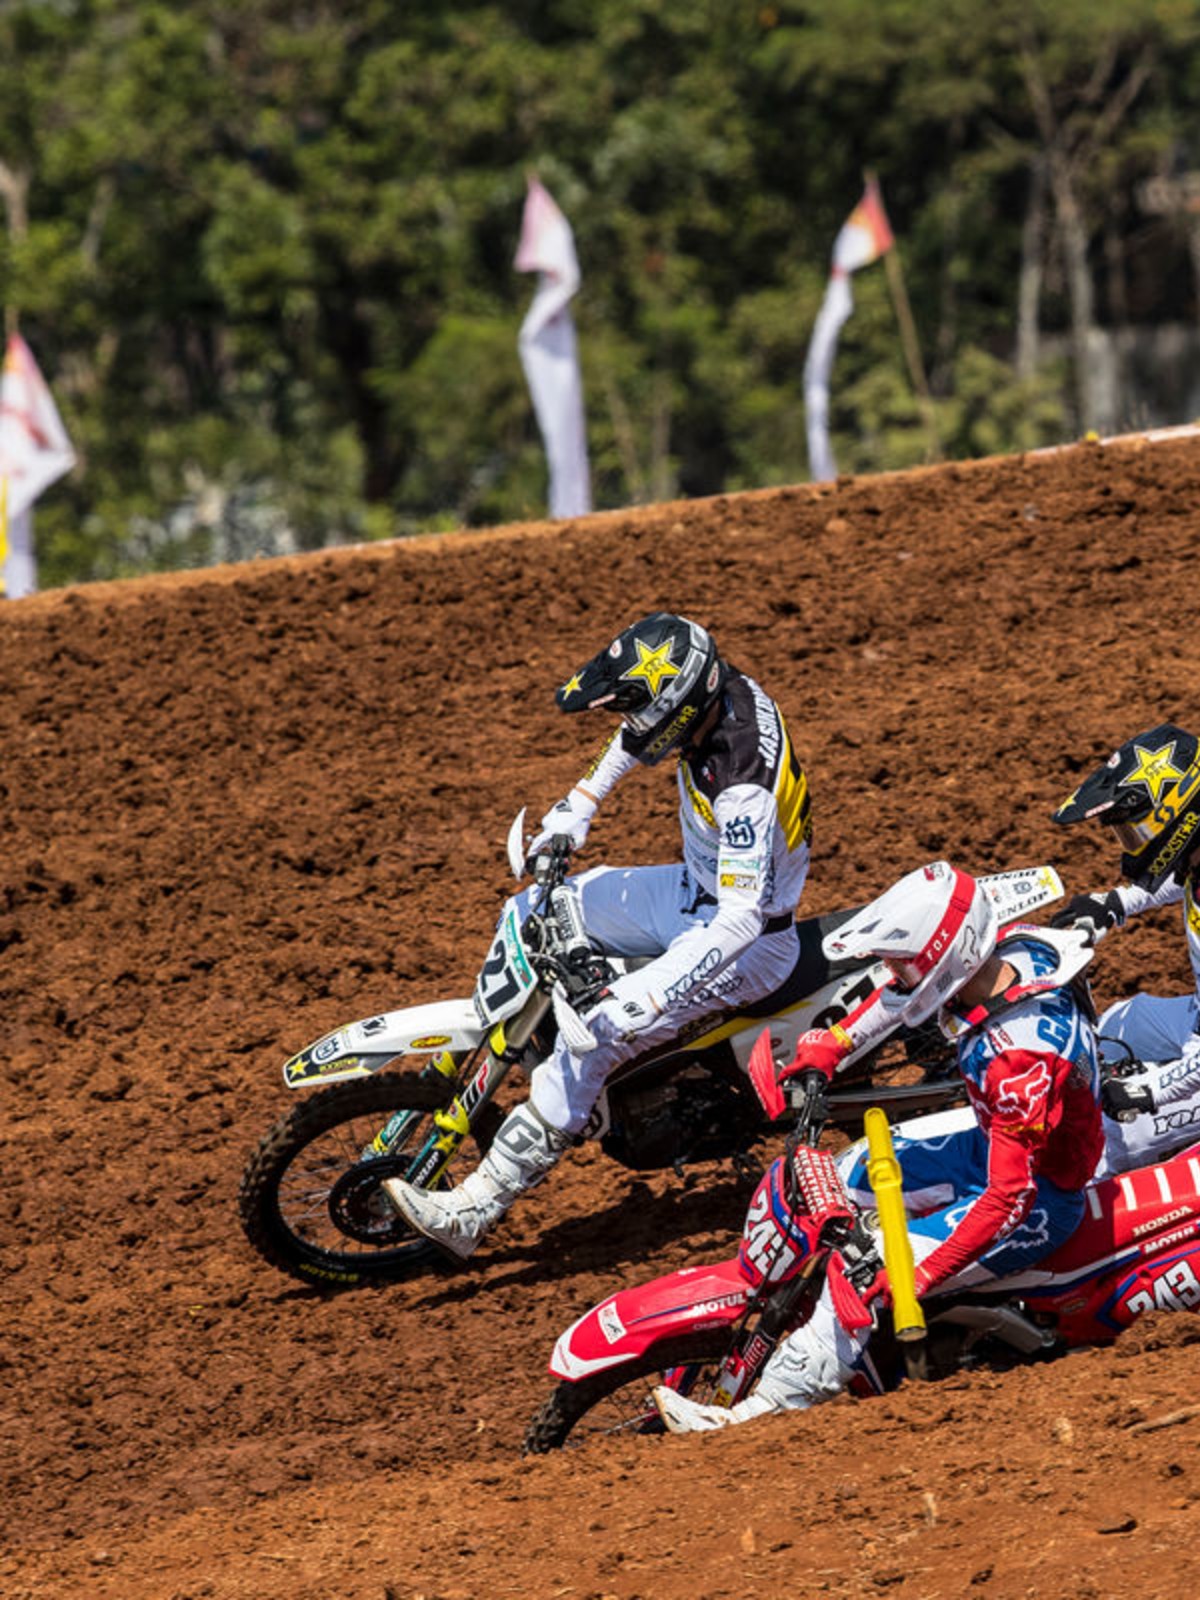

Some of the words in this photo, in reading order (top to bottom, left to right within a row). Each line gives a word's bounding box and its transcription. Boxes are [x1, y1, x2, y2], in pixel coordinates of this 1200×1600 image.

[481, 938, 521, 1013] 27
[1131, 1204, 1194, 1237] HONDA
[691, 1293, 747, 1317] MOTUL
